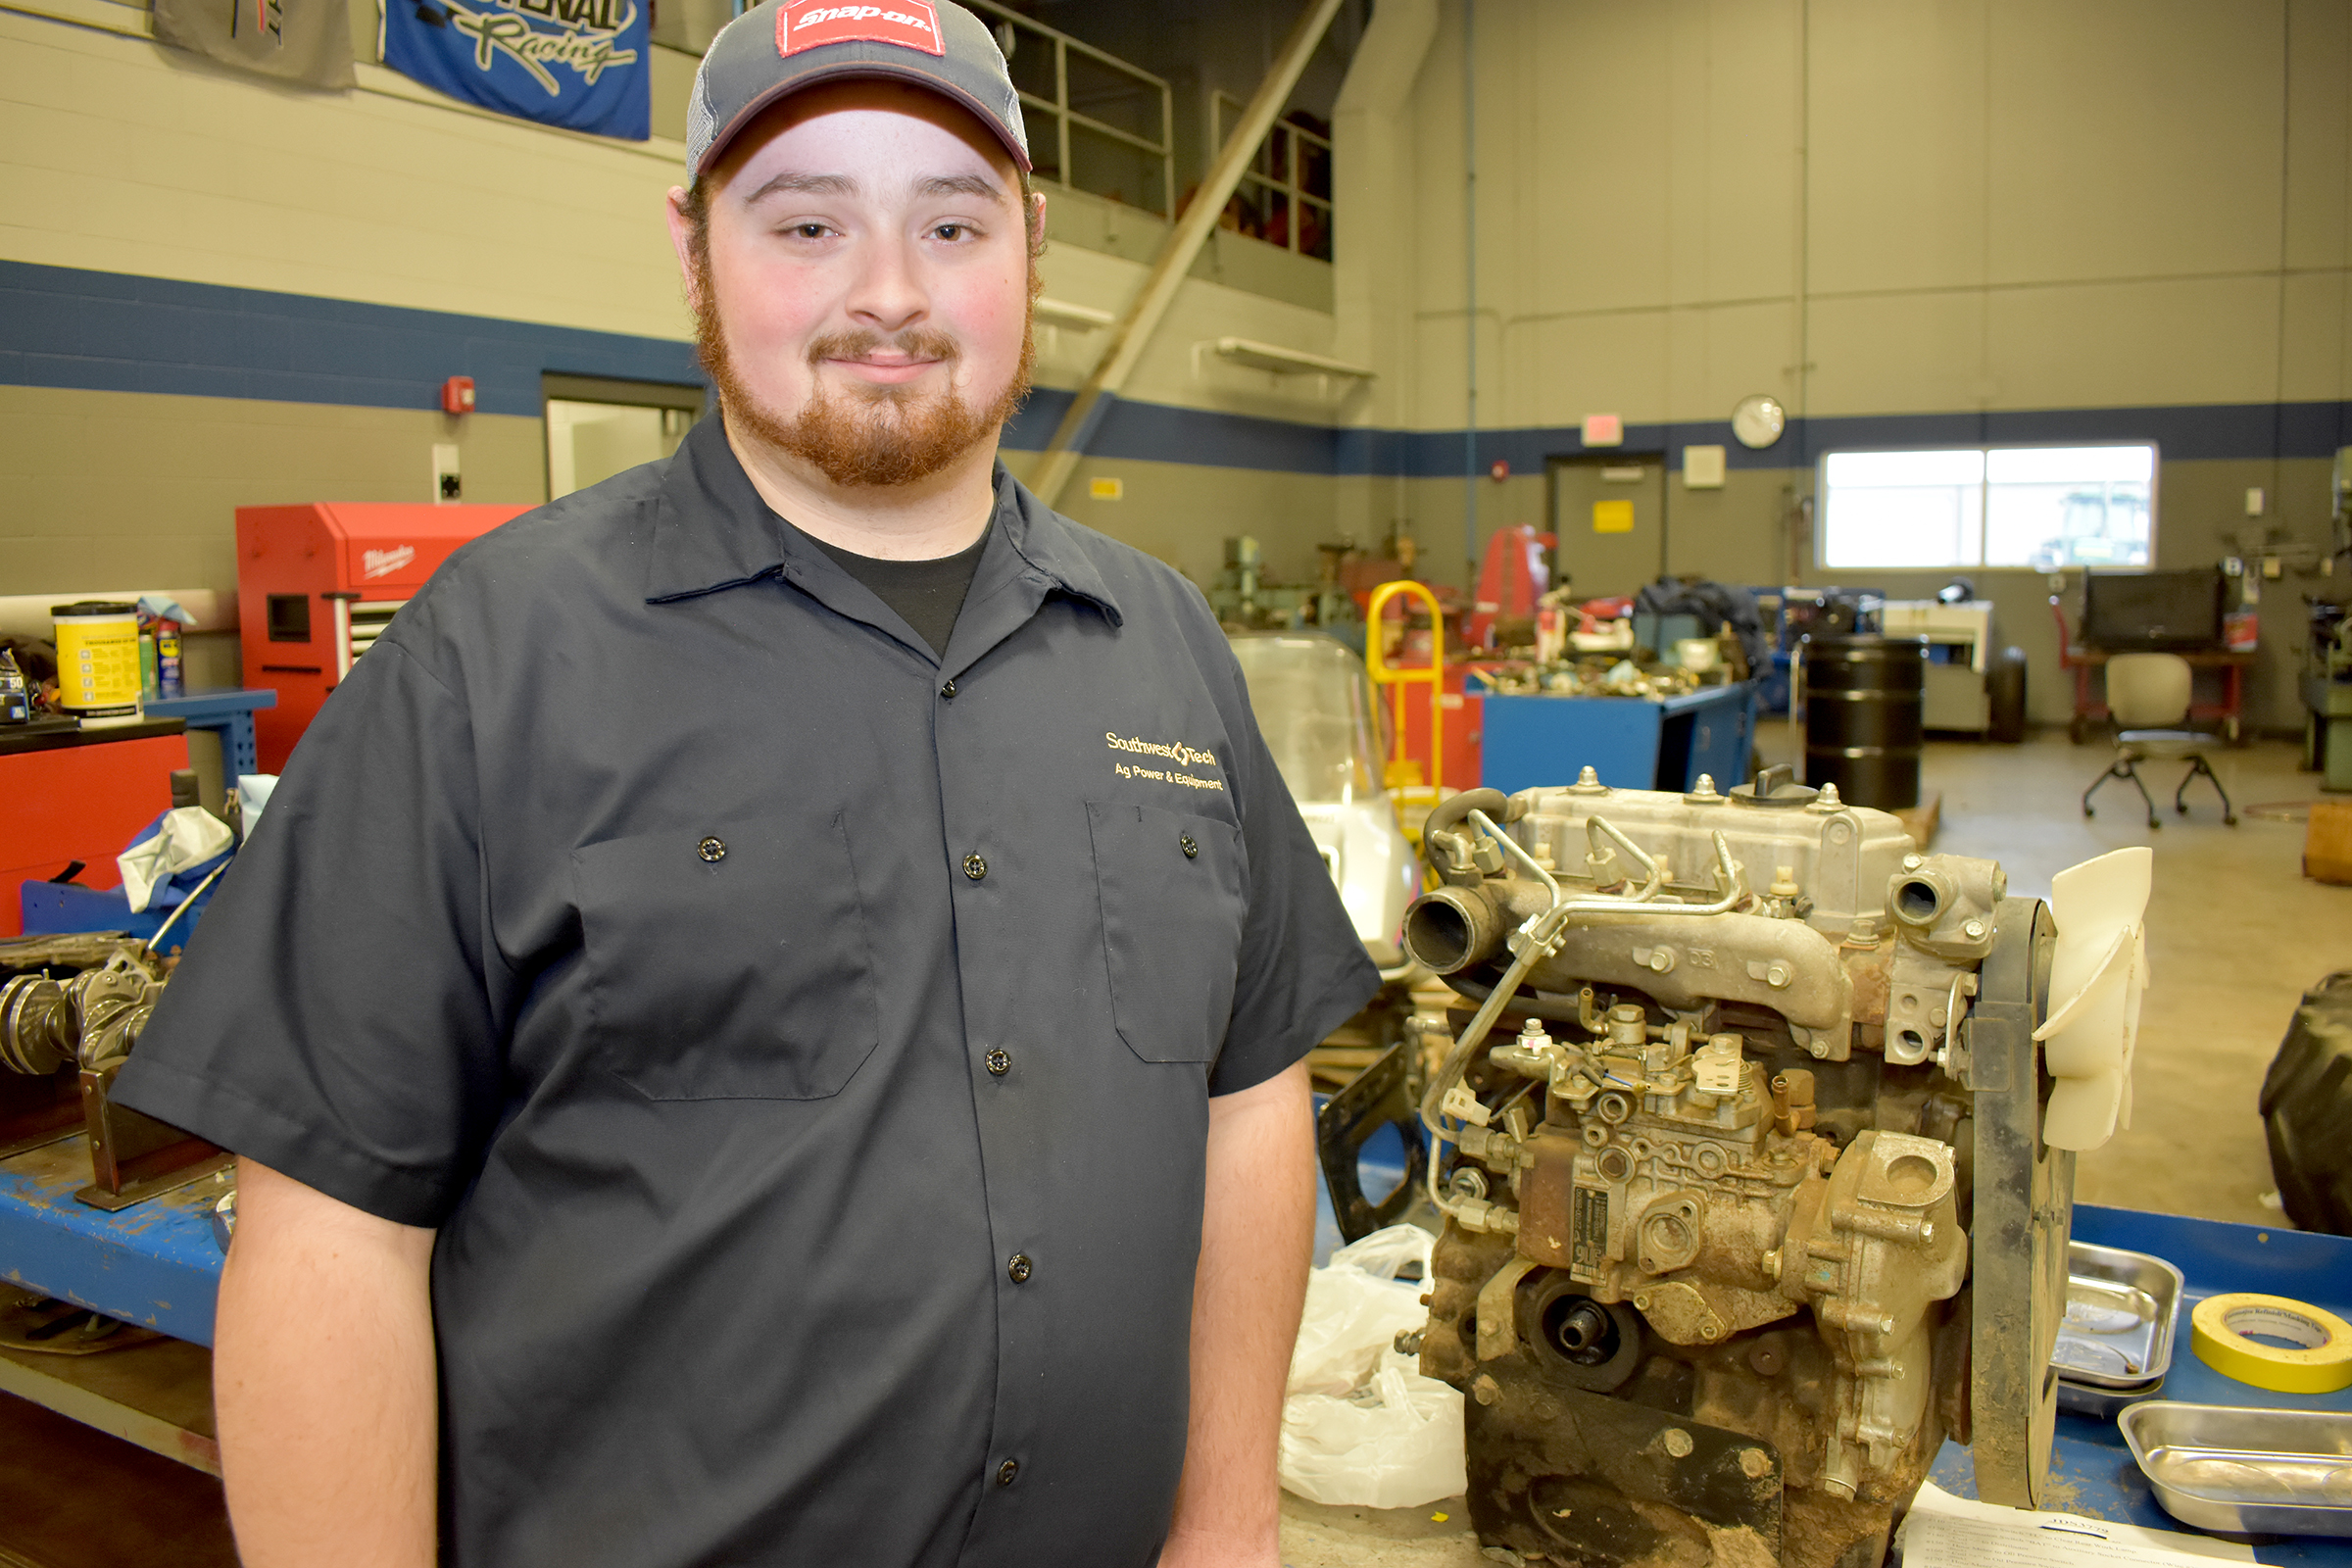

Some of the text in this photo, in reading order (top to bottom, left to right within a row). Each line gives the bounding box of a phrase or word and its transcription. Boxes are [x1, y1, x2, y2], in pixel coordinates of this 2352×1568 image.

[454, 13, 637, 96] Racing
[1105, 731, 1217, 766] Southwest Tech
[1115, 762, 1224, 791] Ag Power & Equipment
[2255, 1308, 2282, 1317] Refinish
